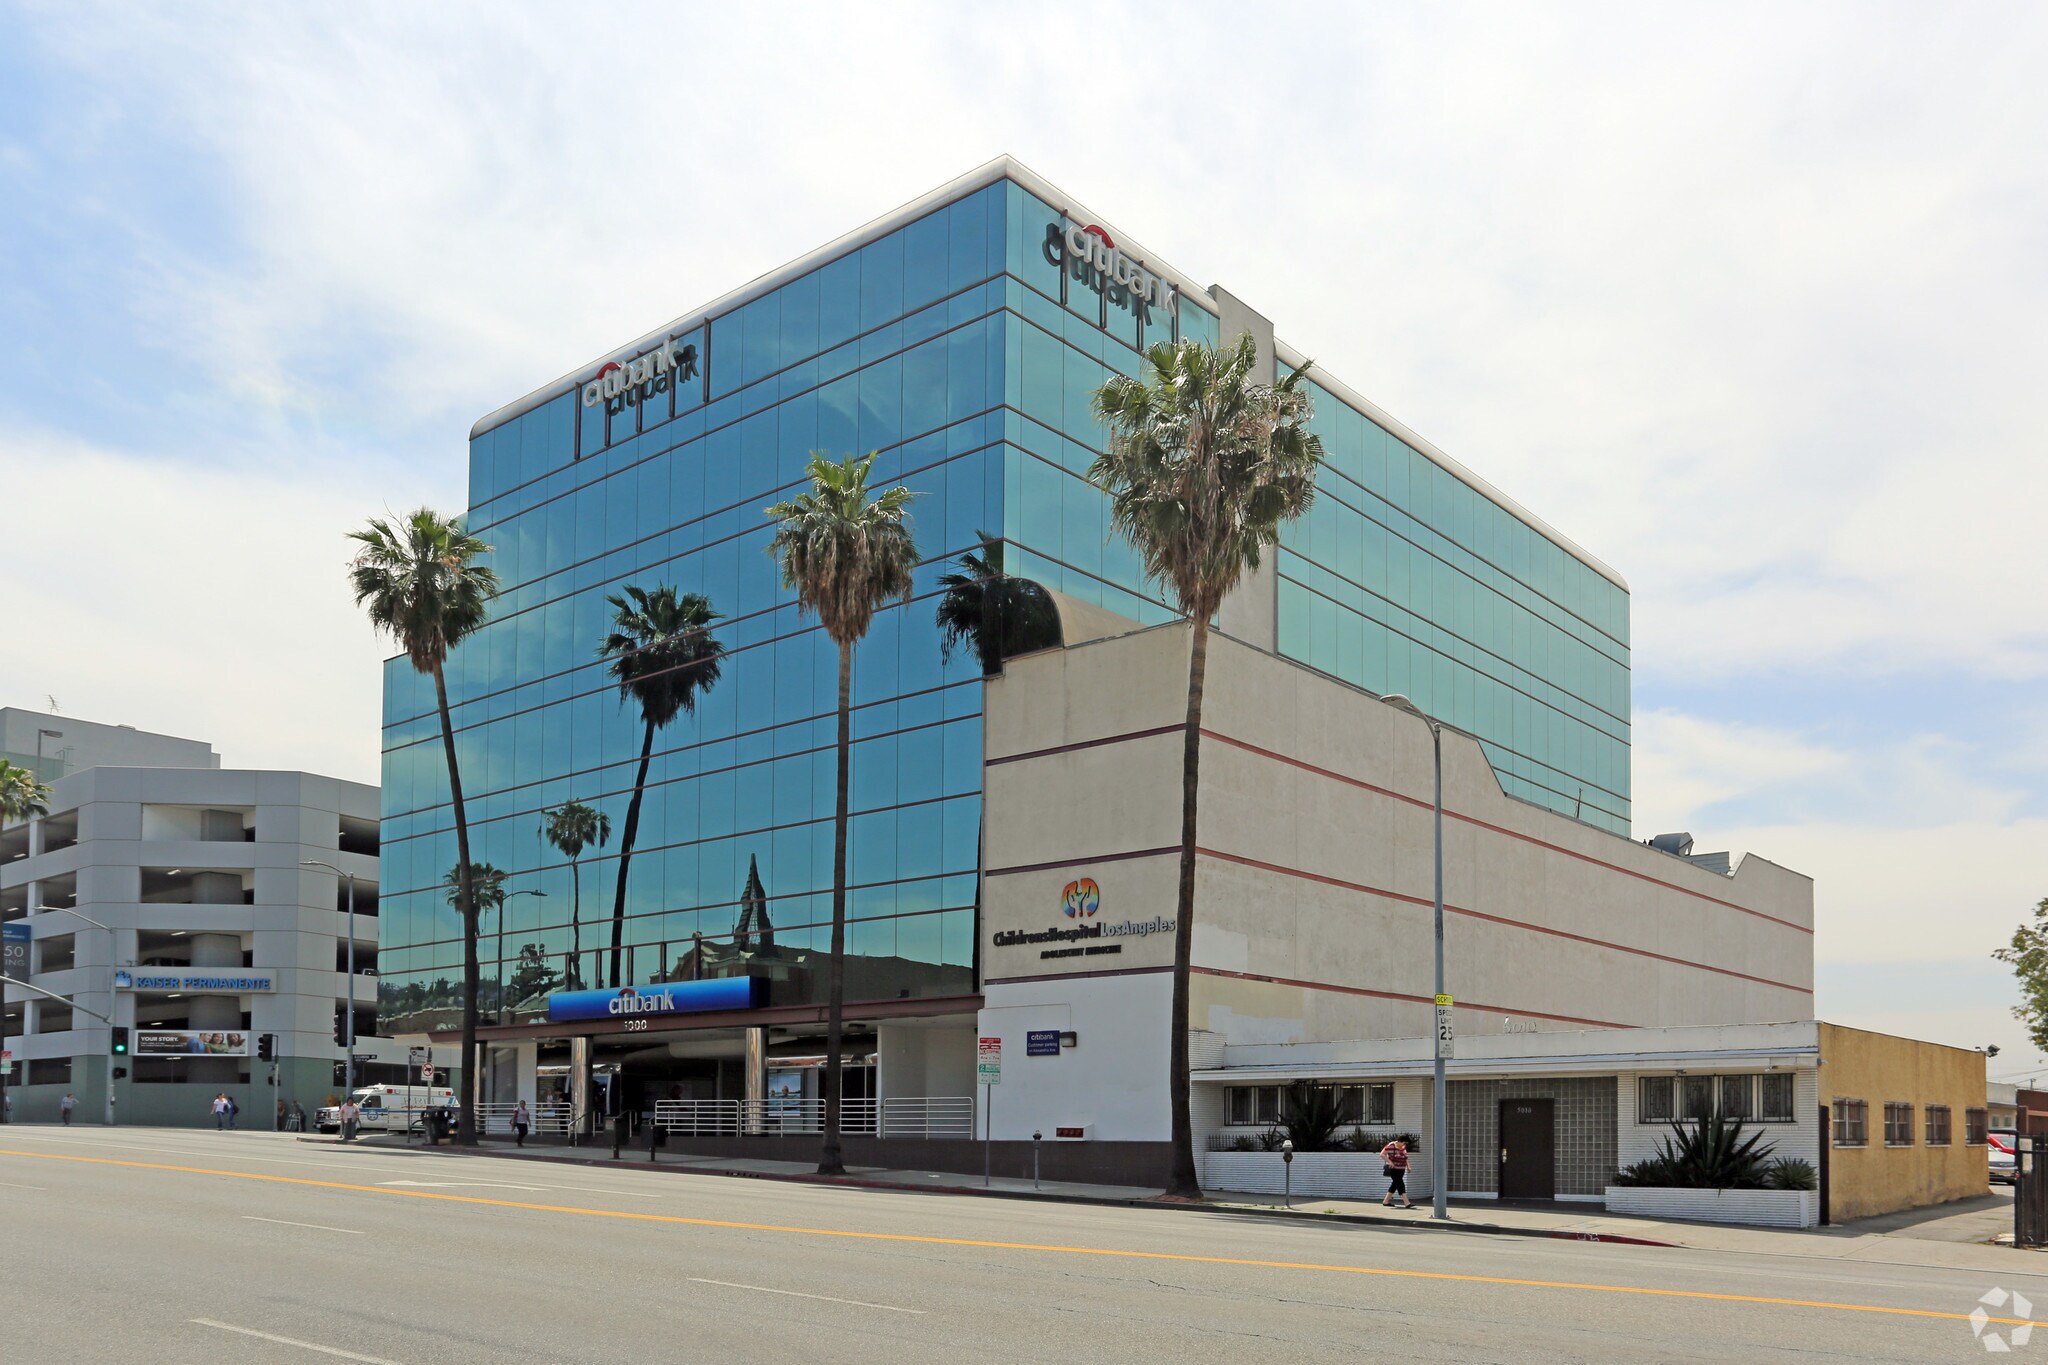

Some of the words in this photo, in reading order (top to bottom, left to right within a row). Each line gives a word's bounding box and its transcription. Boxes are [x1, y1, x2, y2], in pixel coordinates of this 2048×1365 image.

[1065, 224, 1177, 318] citibank
[583, 339, 684, 408] citibank
[136, 976, 180, 989] KAISER
[183, 977, 271, 990] PERMANENTE
[608, 988, 675, 1014] citibank
[1030, 1033, 1054, 1041] citibank
[1440, 1025, 1453, 1041] 25
